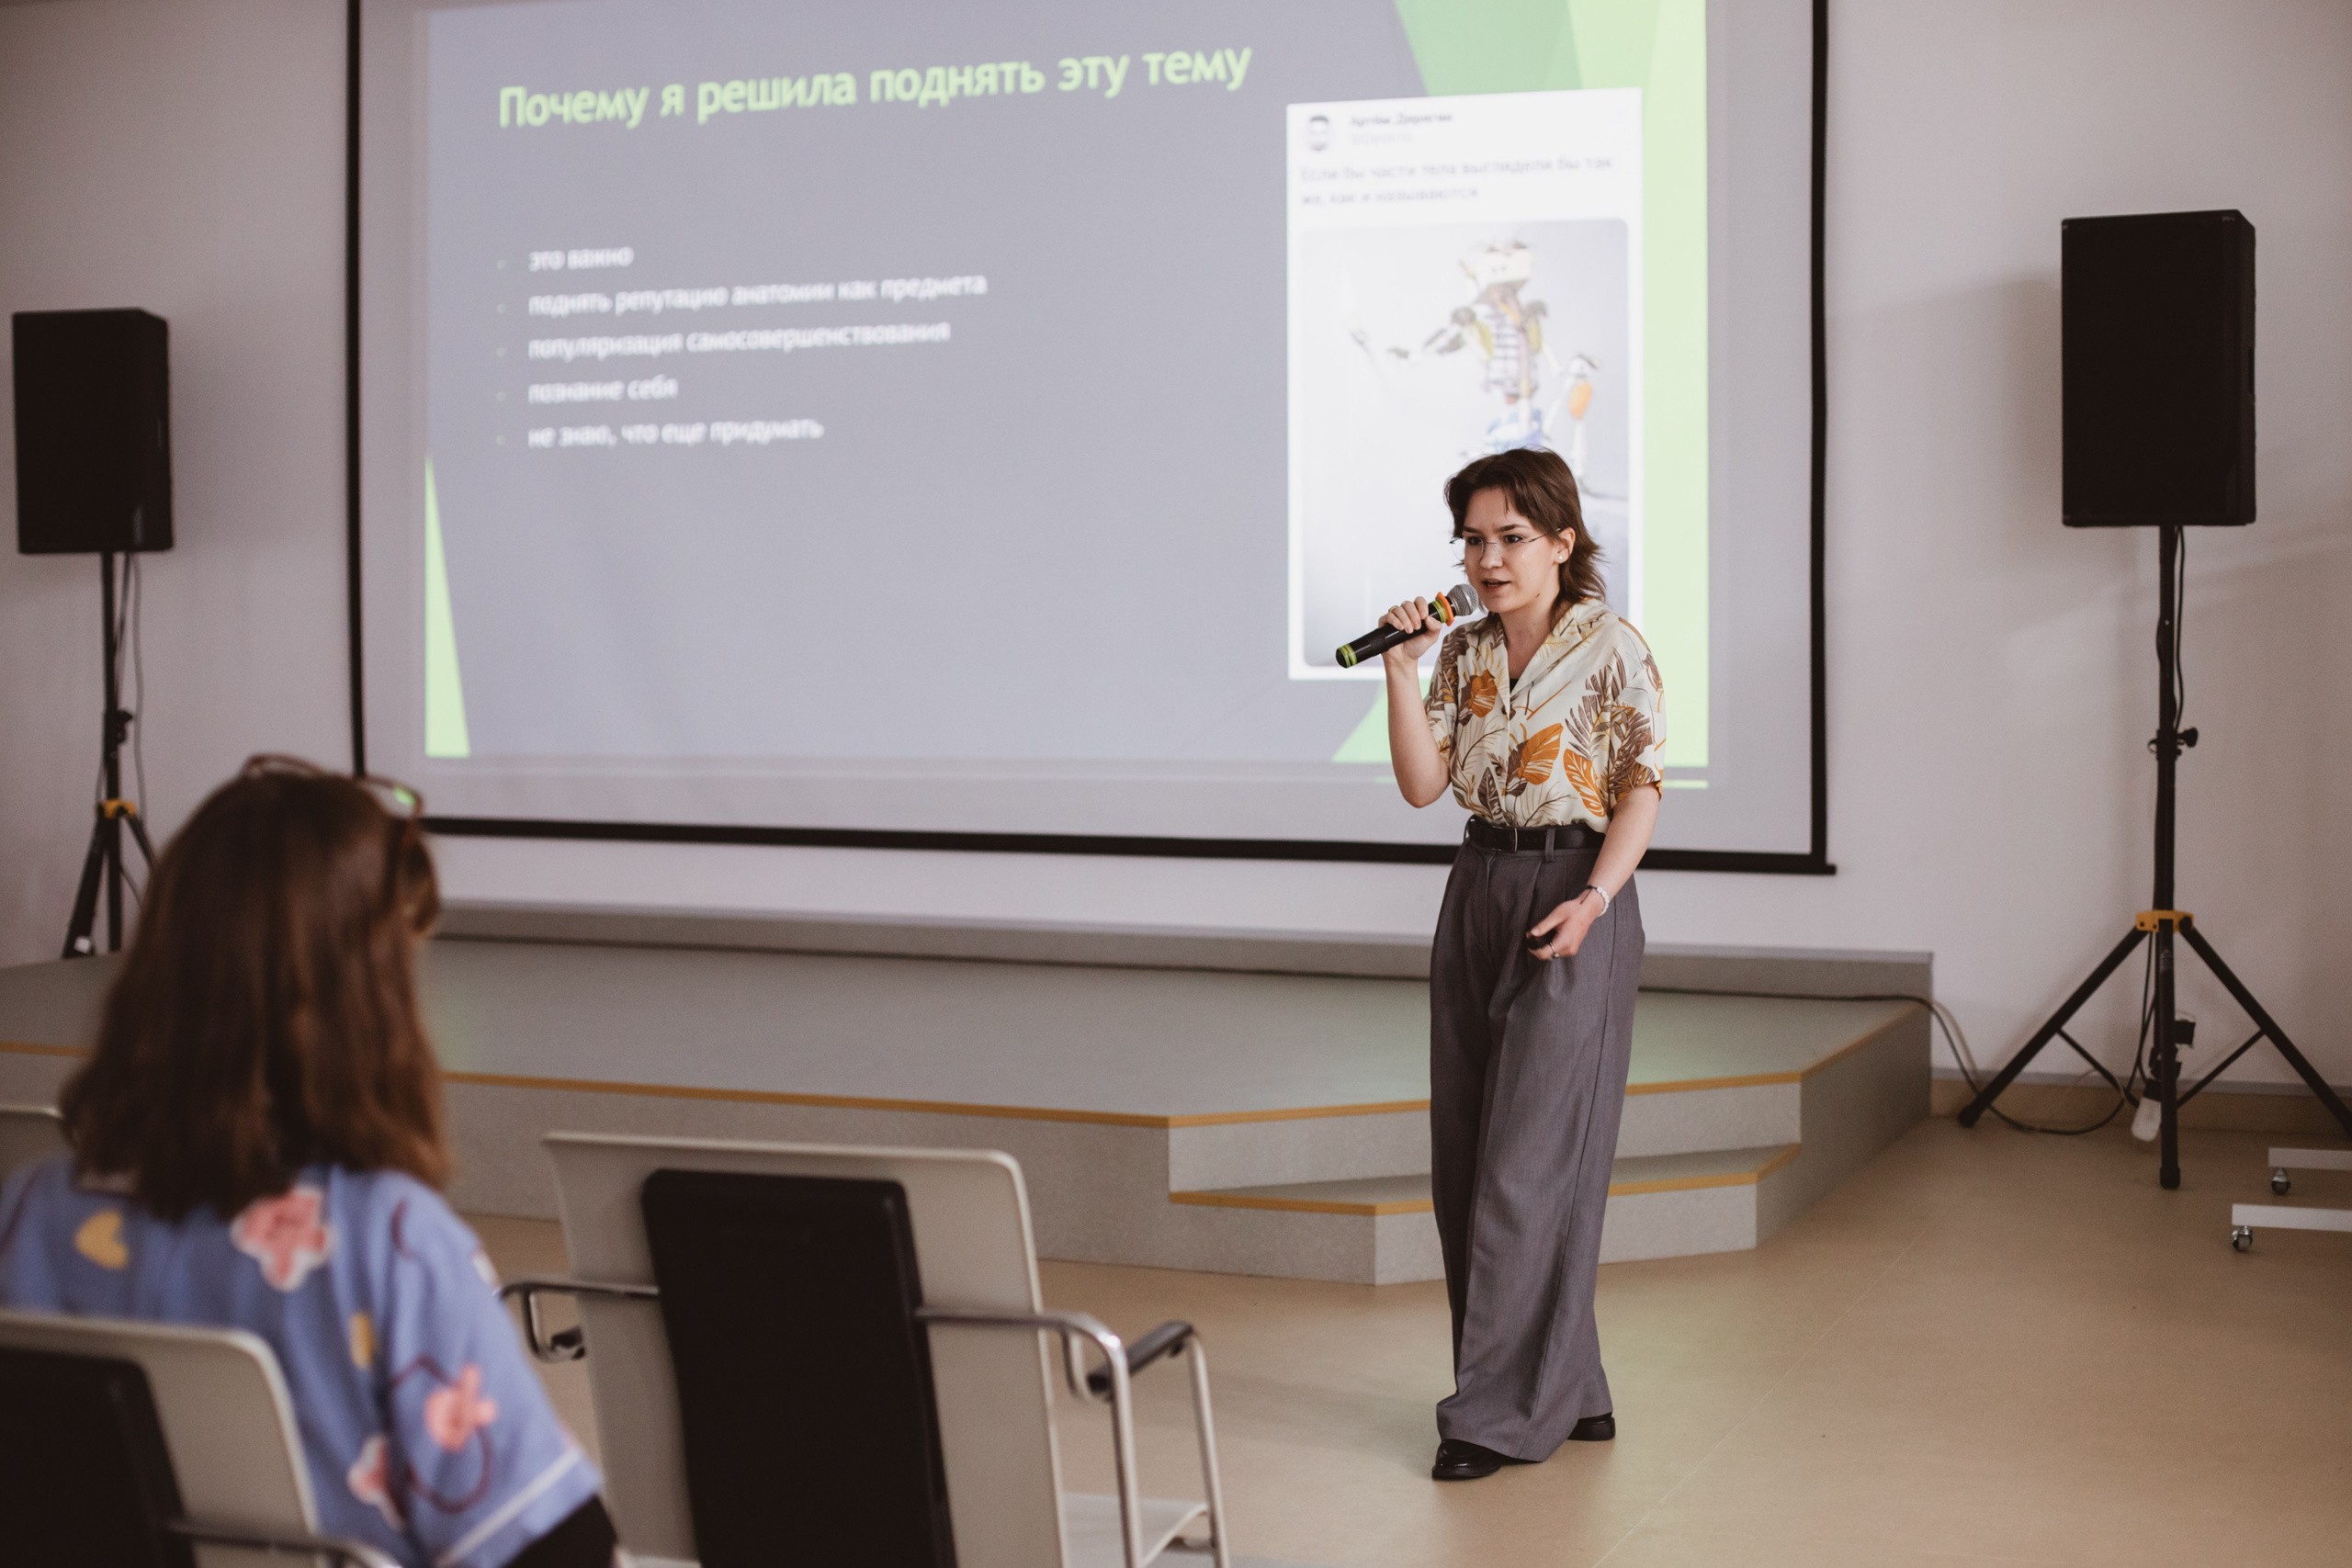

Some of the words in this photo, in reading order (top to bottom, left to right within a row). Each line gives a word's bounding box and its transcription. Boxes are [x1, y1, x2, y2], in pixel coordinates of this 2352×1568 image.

[499, 85, 650, 130] Почему
[660, 83, 685, 117] я
[696, 72, 858, 125] решила
[869, 61, 1046, 108] поднять
[1057, 54, 1131, 99] эту
[1141, 47, 1254, 92] тему
[528, 250, 566, 272] это
[566, 246, 635, 270] важно
[528, 292, 614, 318] поднять
[615, 287, 729, 316] репутацию
[731, 283, 835, 306] анатомии
[837, 280, 877, 300] как
[880, 275, 989, 303] предмета
[528, 333, 684, 362] популяризация
[685, 321, 952, 354] самосовершенствования
[528, 380, 626, 404] познание
[627, 374, 680, 400] себя
[528, 427, 557, 448] не
[558, 424, 618, 448] знаю,
[621, 423, 660, 445] что
[709, 418, 826, 446] придумать
